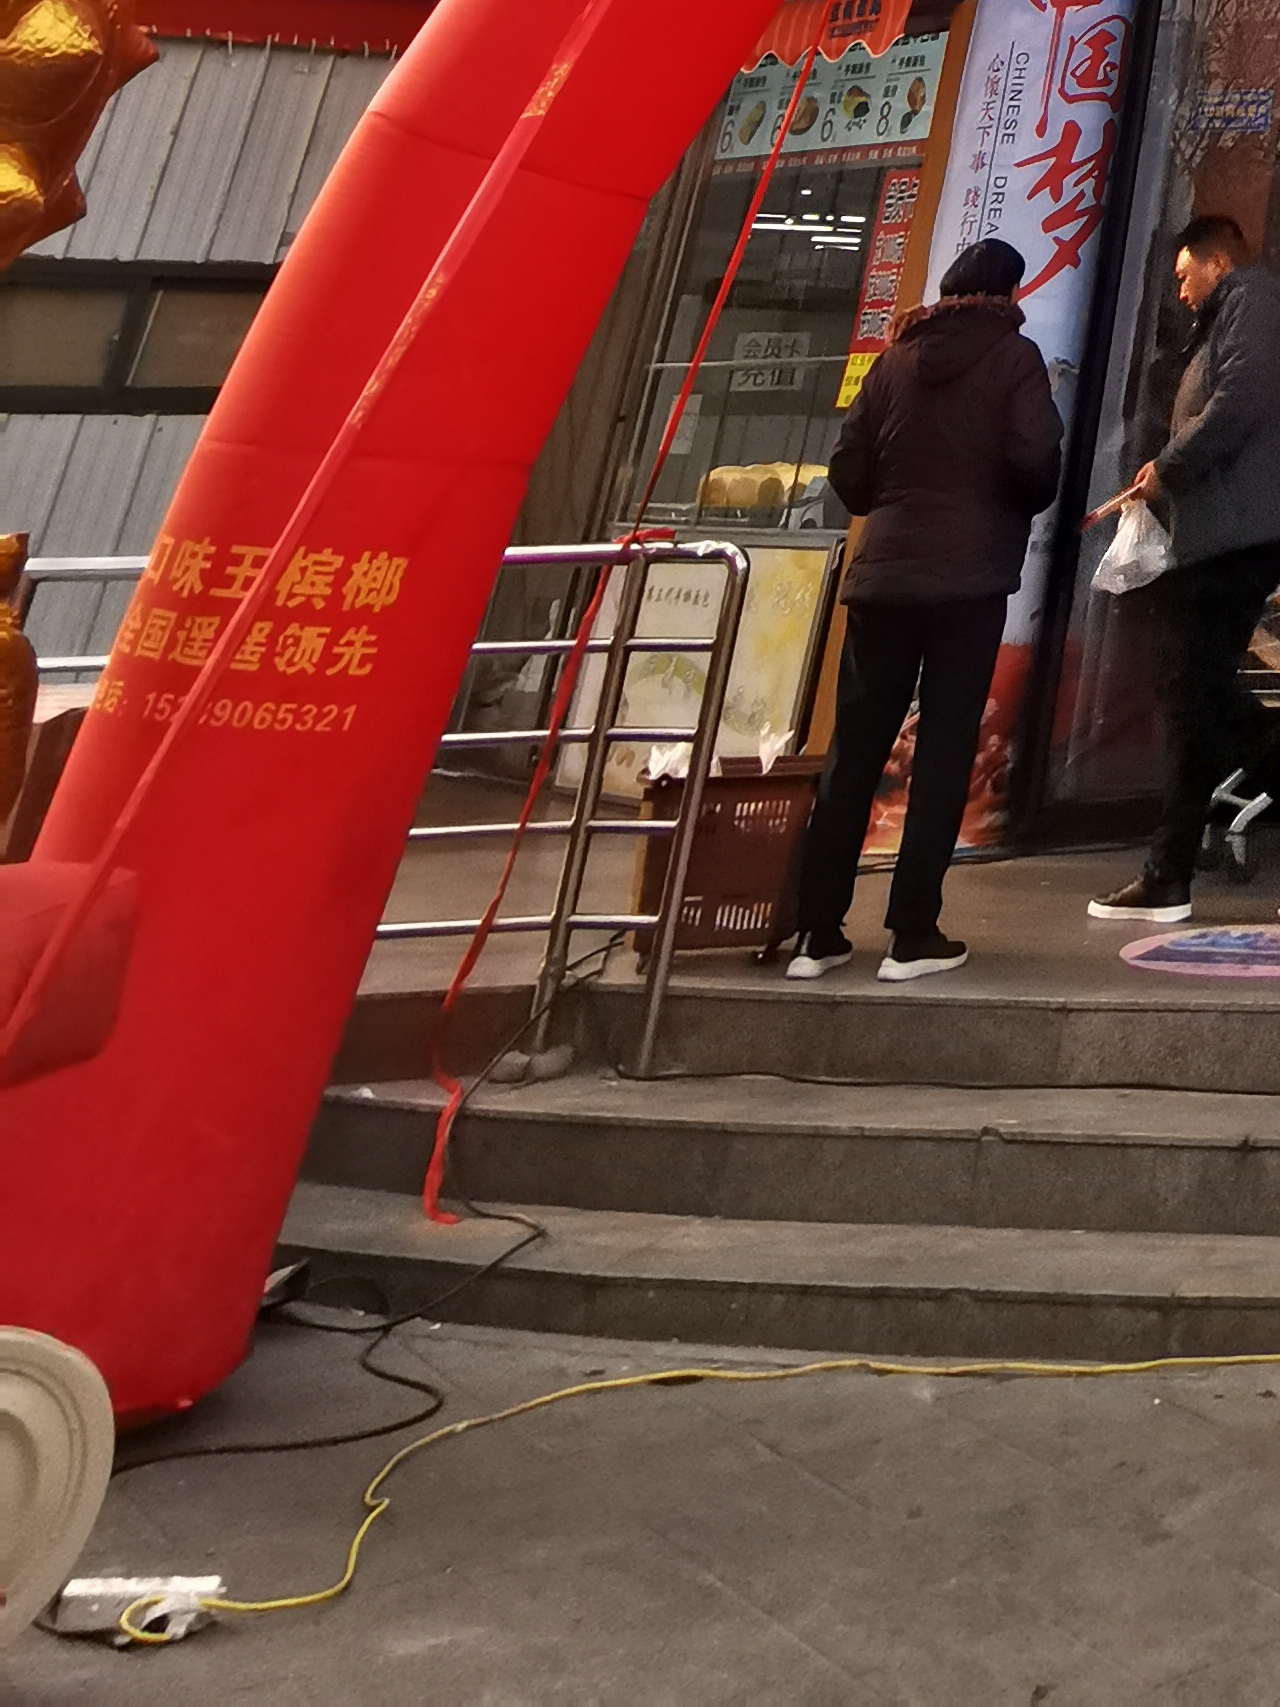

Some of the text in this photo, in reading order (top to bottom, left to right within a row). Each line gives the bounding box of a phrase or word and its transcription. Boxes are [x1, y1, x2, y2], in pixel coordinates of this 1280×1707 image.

[983, 51, 1030, 235] CHINESE DREA
[147, 533, 411, 613] 口味王槟榔
